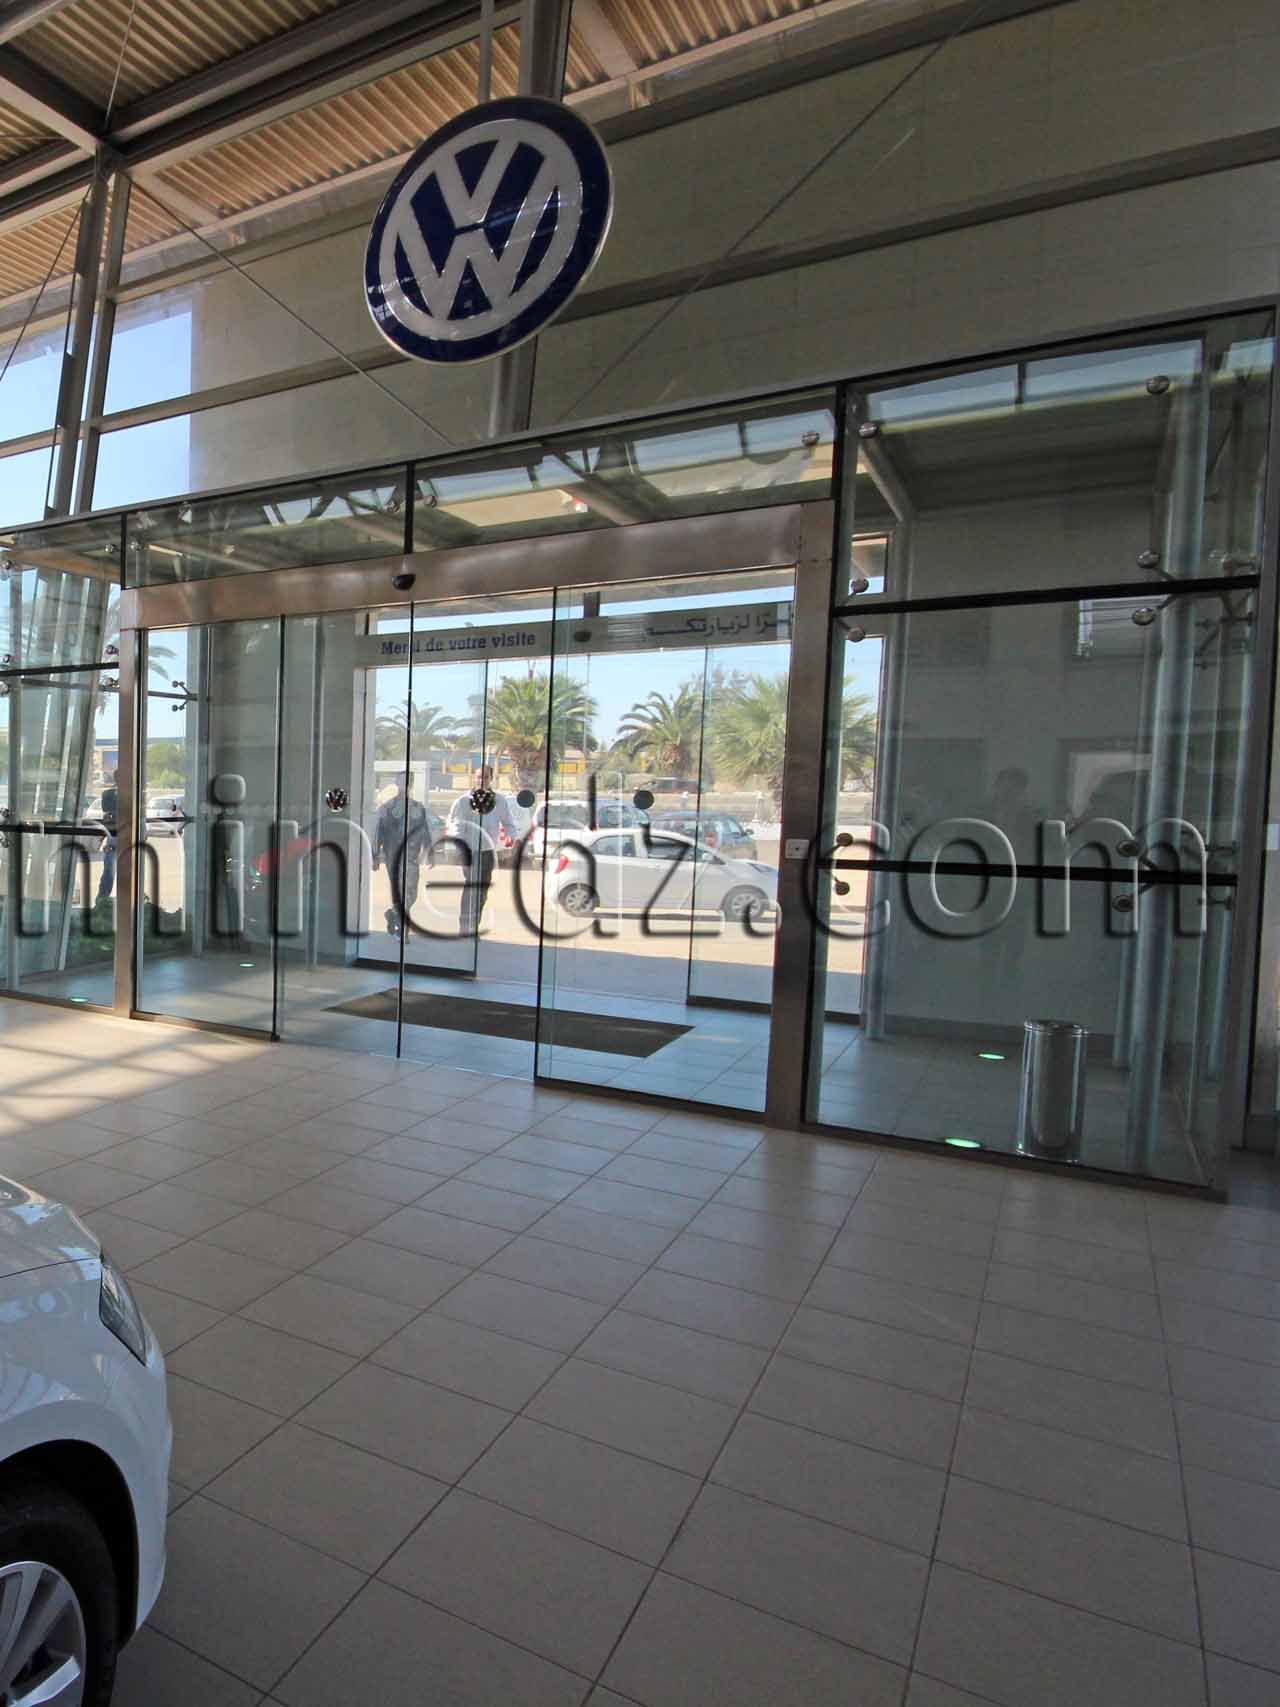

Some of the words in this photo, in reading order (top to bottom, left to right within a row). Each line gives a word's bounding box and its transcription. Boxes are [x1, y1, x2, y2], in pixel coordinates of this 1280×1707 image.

[378, 117, 584, 340] VW
[425, 636, 443, 652] de
[448, 635, 487, 651] votre
[491, 631, 536, 649] visite
